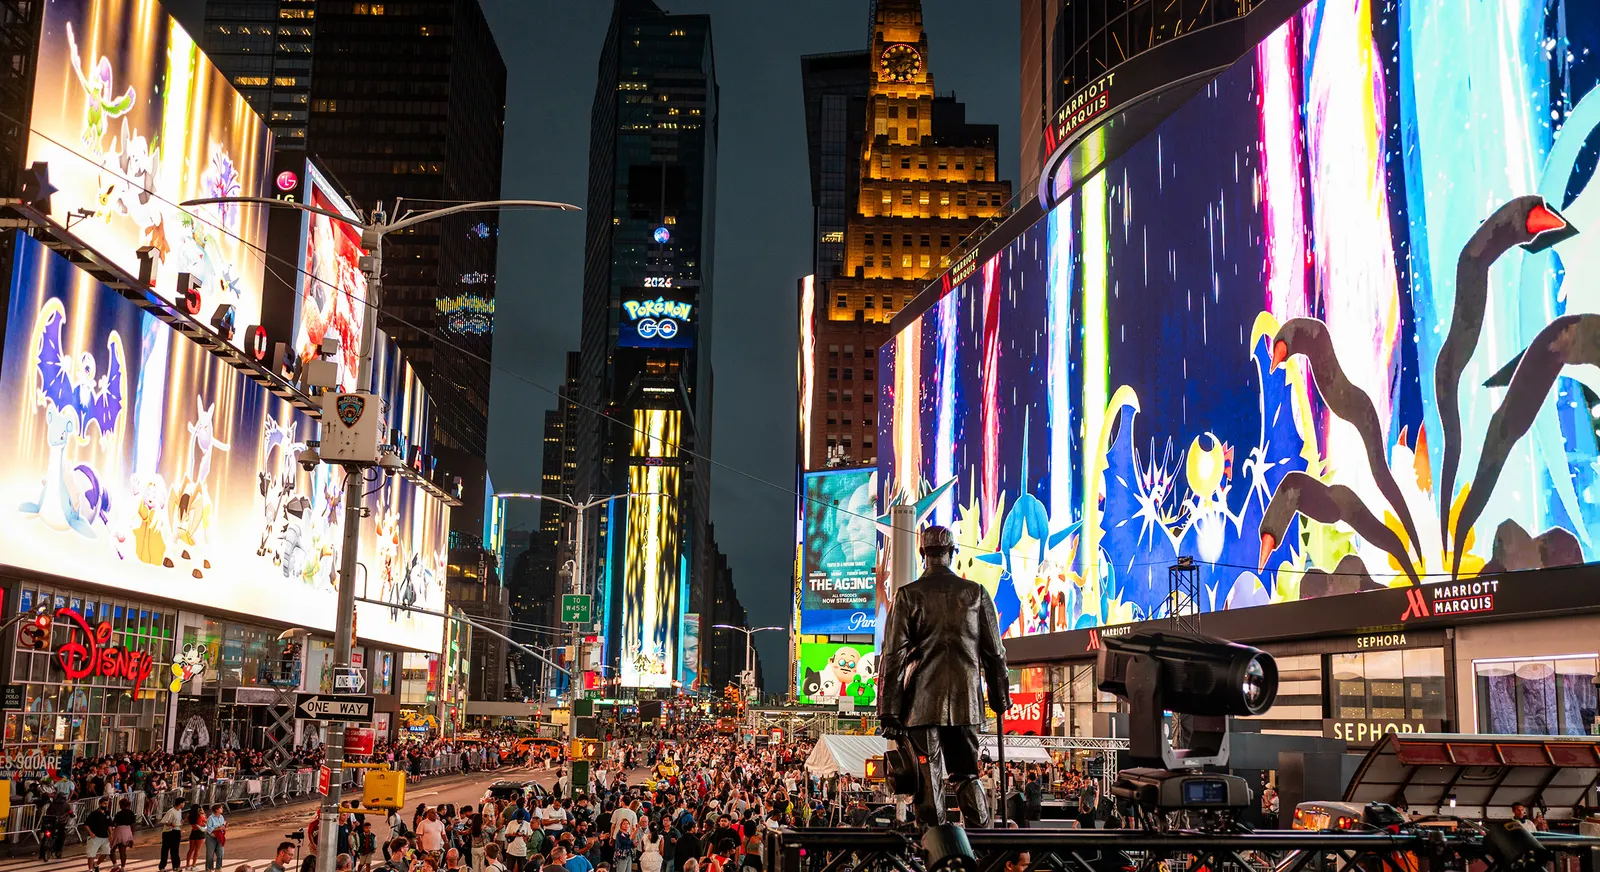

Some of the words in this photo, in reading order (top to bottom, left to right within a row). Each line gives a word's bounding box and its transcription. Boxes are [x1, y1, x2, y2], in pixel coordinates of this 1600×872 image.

[1059, 73, 1115, 124] MARRIOTT
[1060, 95, 1106, 140] MARQUIS
[953, 248, 979, 275] MARRIOTT
[953, 262, 976, 286] MARQUIS
[637, 318, 678, 339] GO
[809, 579, 832, 591] THE
[1435, 581, 1498, 599] MARRIOTT
[1435, 598, 1492, 613] MARQUIS
[1101, 627, 1131, 637] MARRIOTT
[1357, 634, 1407, 648] SEPHORA
[338, 677, 349, 686] ONE
[307, 702, 329, 712] ONE
[340, 703, 364, 714] WAY
[17, 755, 62, 770] SQUARE
